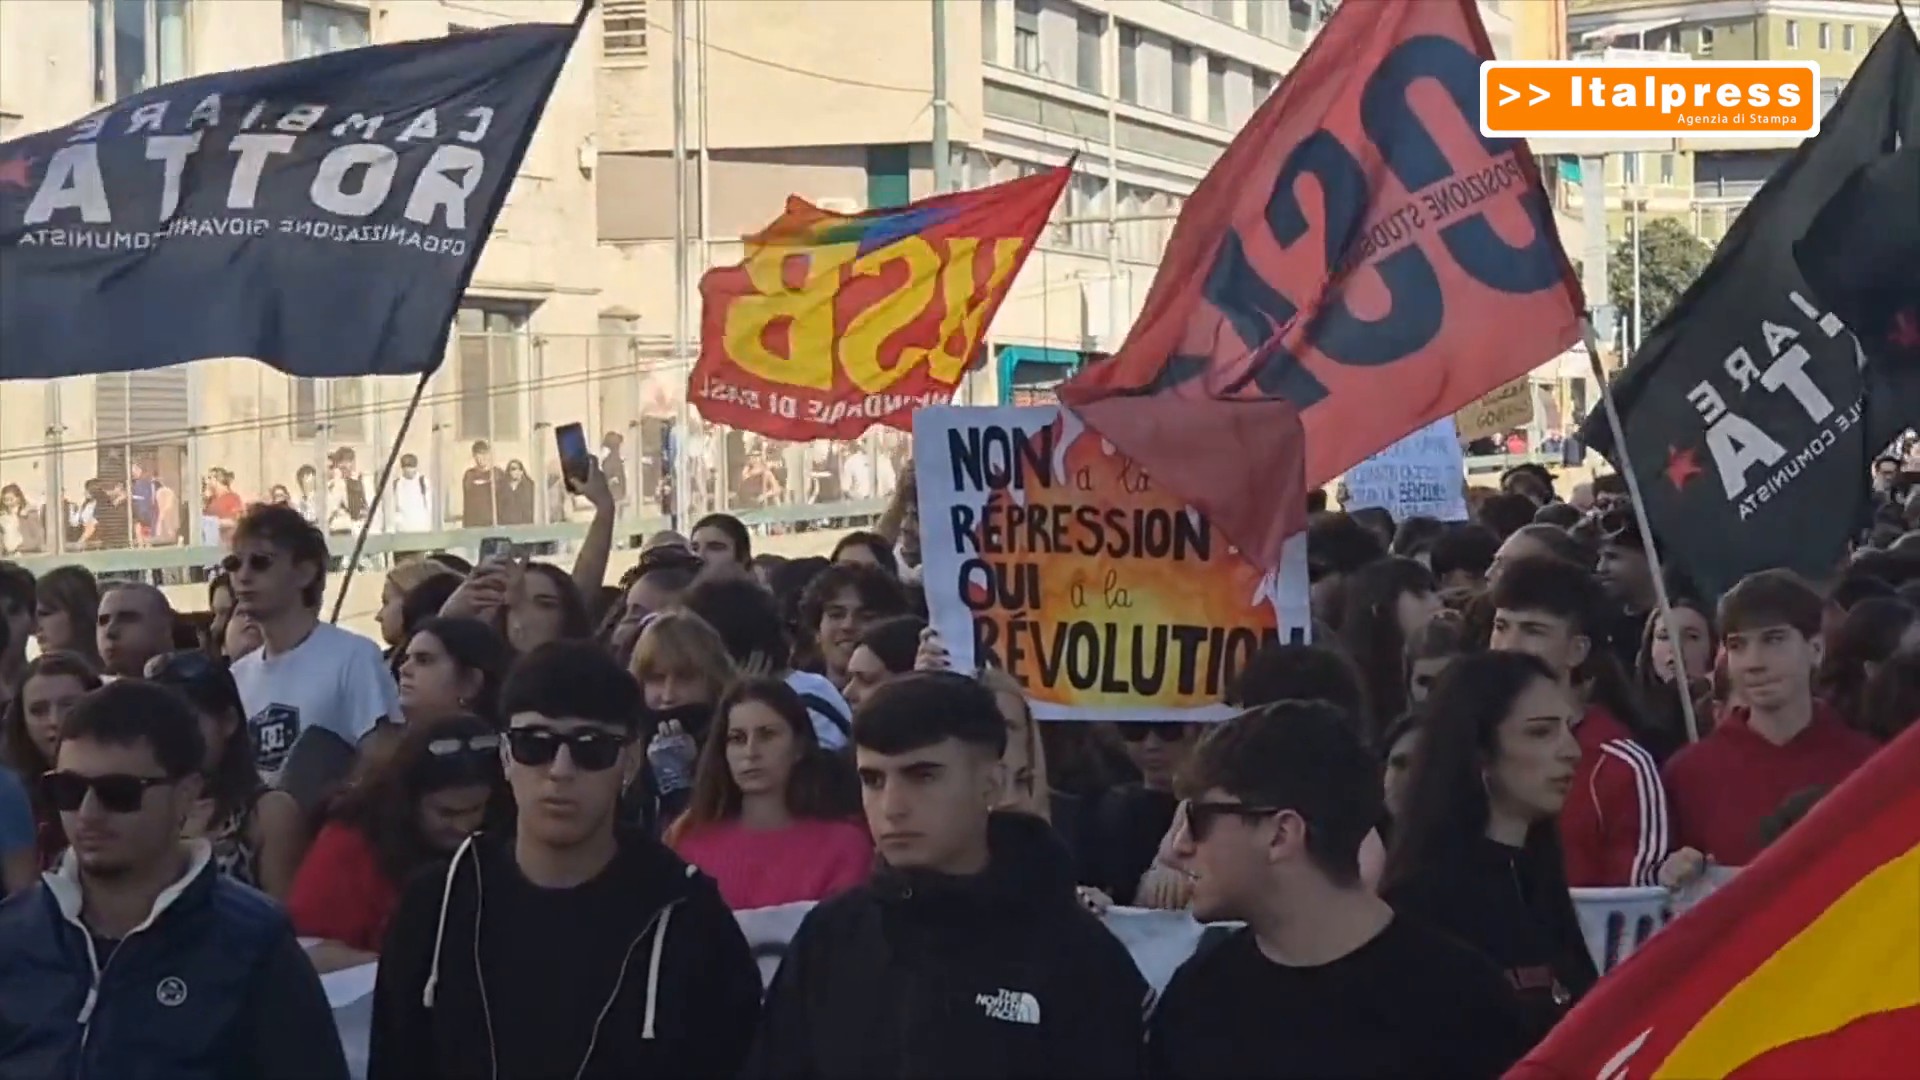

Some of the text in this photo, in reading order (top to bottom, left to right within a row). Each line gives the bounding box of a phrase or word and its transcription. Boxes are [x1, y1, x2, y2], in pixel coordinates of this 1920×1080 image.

[948, 426, 1052, 491] NON
[950, 494, 1210, 561] RÉPRESSION
[958, 558, 1040, 612] OUI
[1104, 568, 1132, 609] la
[975, 992, 1019, 1012] NORTH
[998, 987, 1021, 1001] THE
[985, 1004, 1020, 1022] FACE
